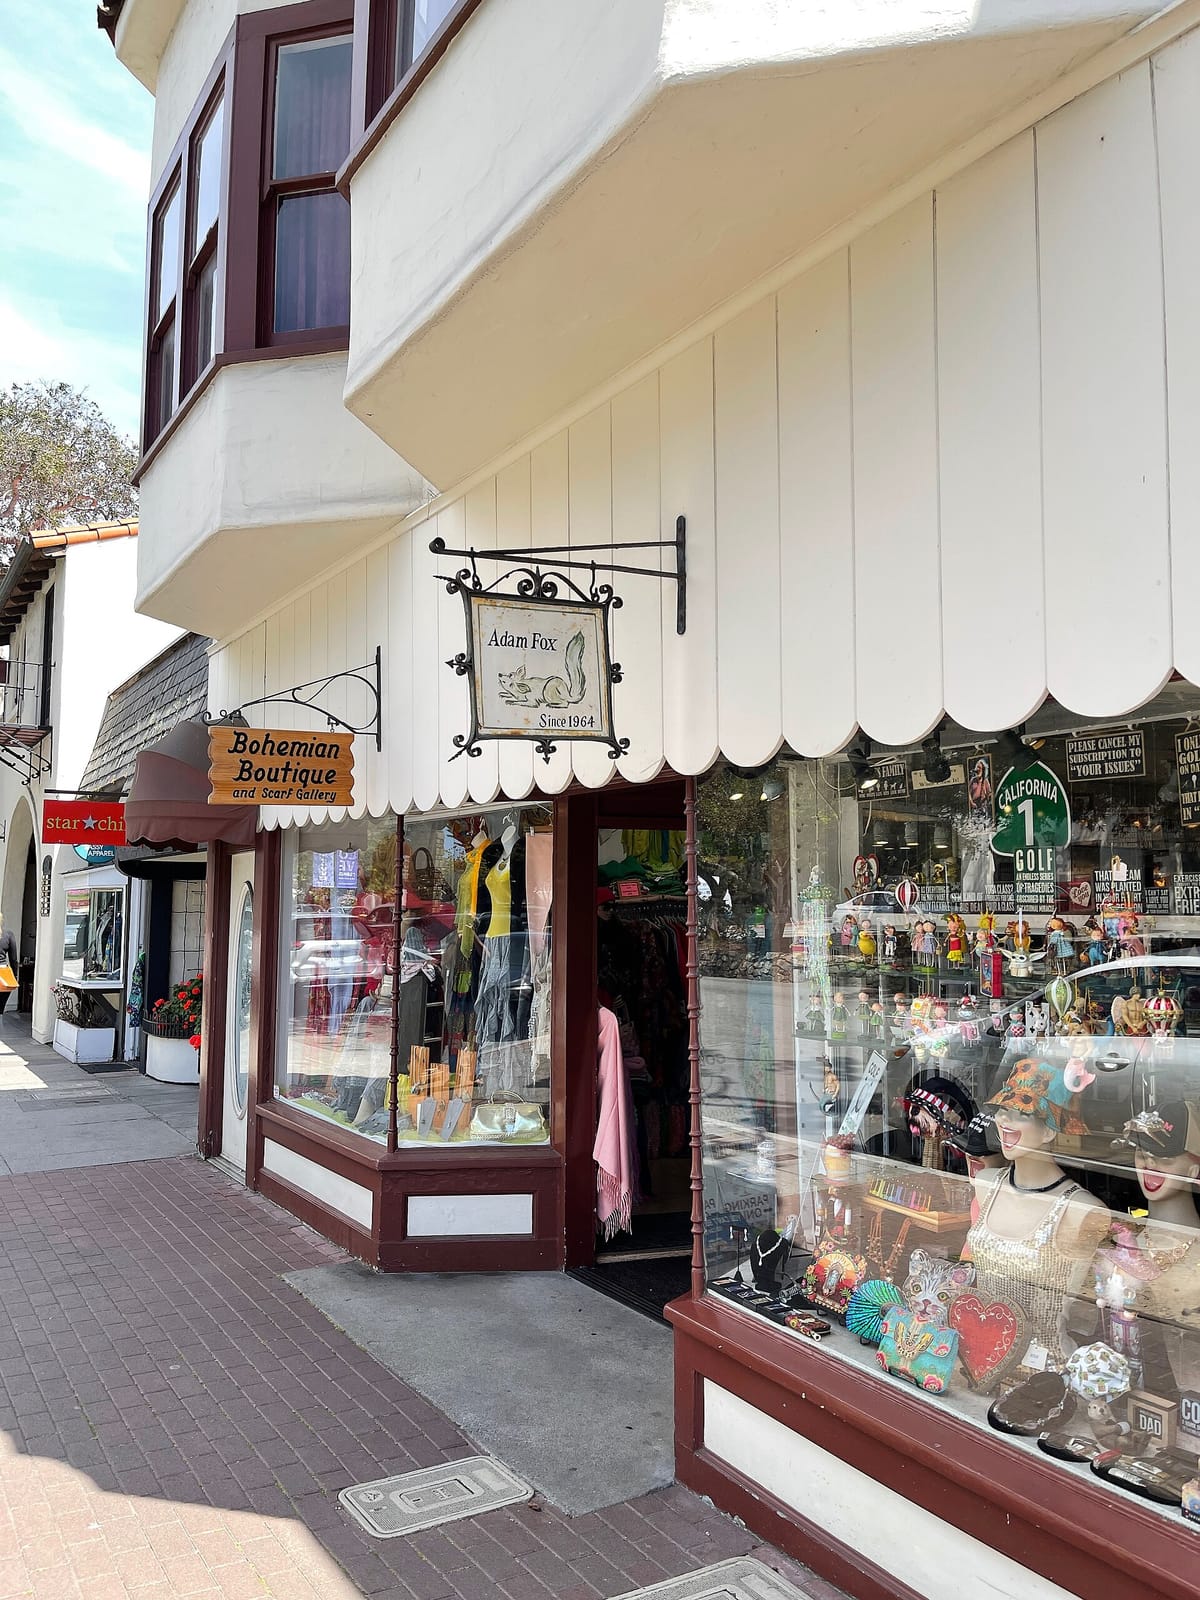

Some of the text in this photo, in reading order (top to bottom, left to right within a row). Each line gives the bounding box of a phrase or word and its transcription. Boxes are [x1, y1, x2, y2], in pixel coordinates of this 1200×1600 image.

[487, 629, 558, 651] Adam Fox
[539, 713, 595, 728] Since 1964
[228, 730, 340, 759] Bohemian
[1068, 734, 1141, 753] PLEASE CANCEL MY
[1184, 735, 1200, 751] ONL
[1069, 747, 1141, 764] SUBSCRIPTION TO
[1179, 750, 1200, 765] GOL
[232, 759, 337, 788] Boutique
[882, 763, 905, 778] FAMILY
[1190, 763, 1200, 774] DA
[232, 787, 336, 803] and Scarf Gallery
[999, 778, 1058, 810] CALIFORNIA
[46, 816, 126, 832] star chi
[1017, 799, 1035, 846] 1
[1016, 848, 1053, 872] GOLF
[1094, 870, 1112, 881] THAT
[1024, 882, 1054, 893] TRAGEDIES
[1095, 882, 1110, 892] WAS
[1174, 886, 1200, 899] EXTR
[1175, 899, 1200, 914] FRIE
[1181, 1398, 1200, 1425] CO
[1140, 1414, 1162, 1436] DAD
